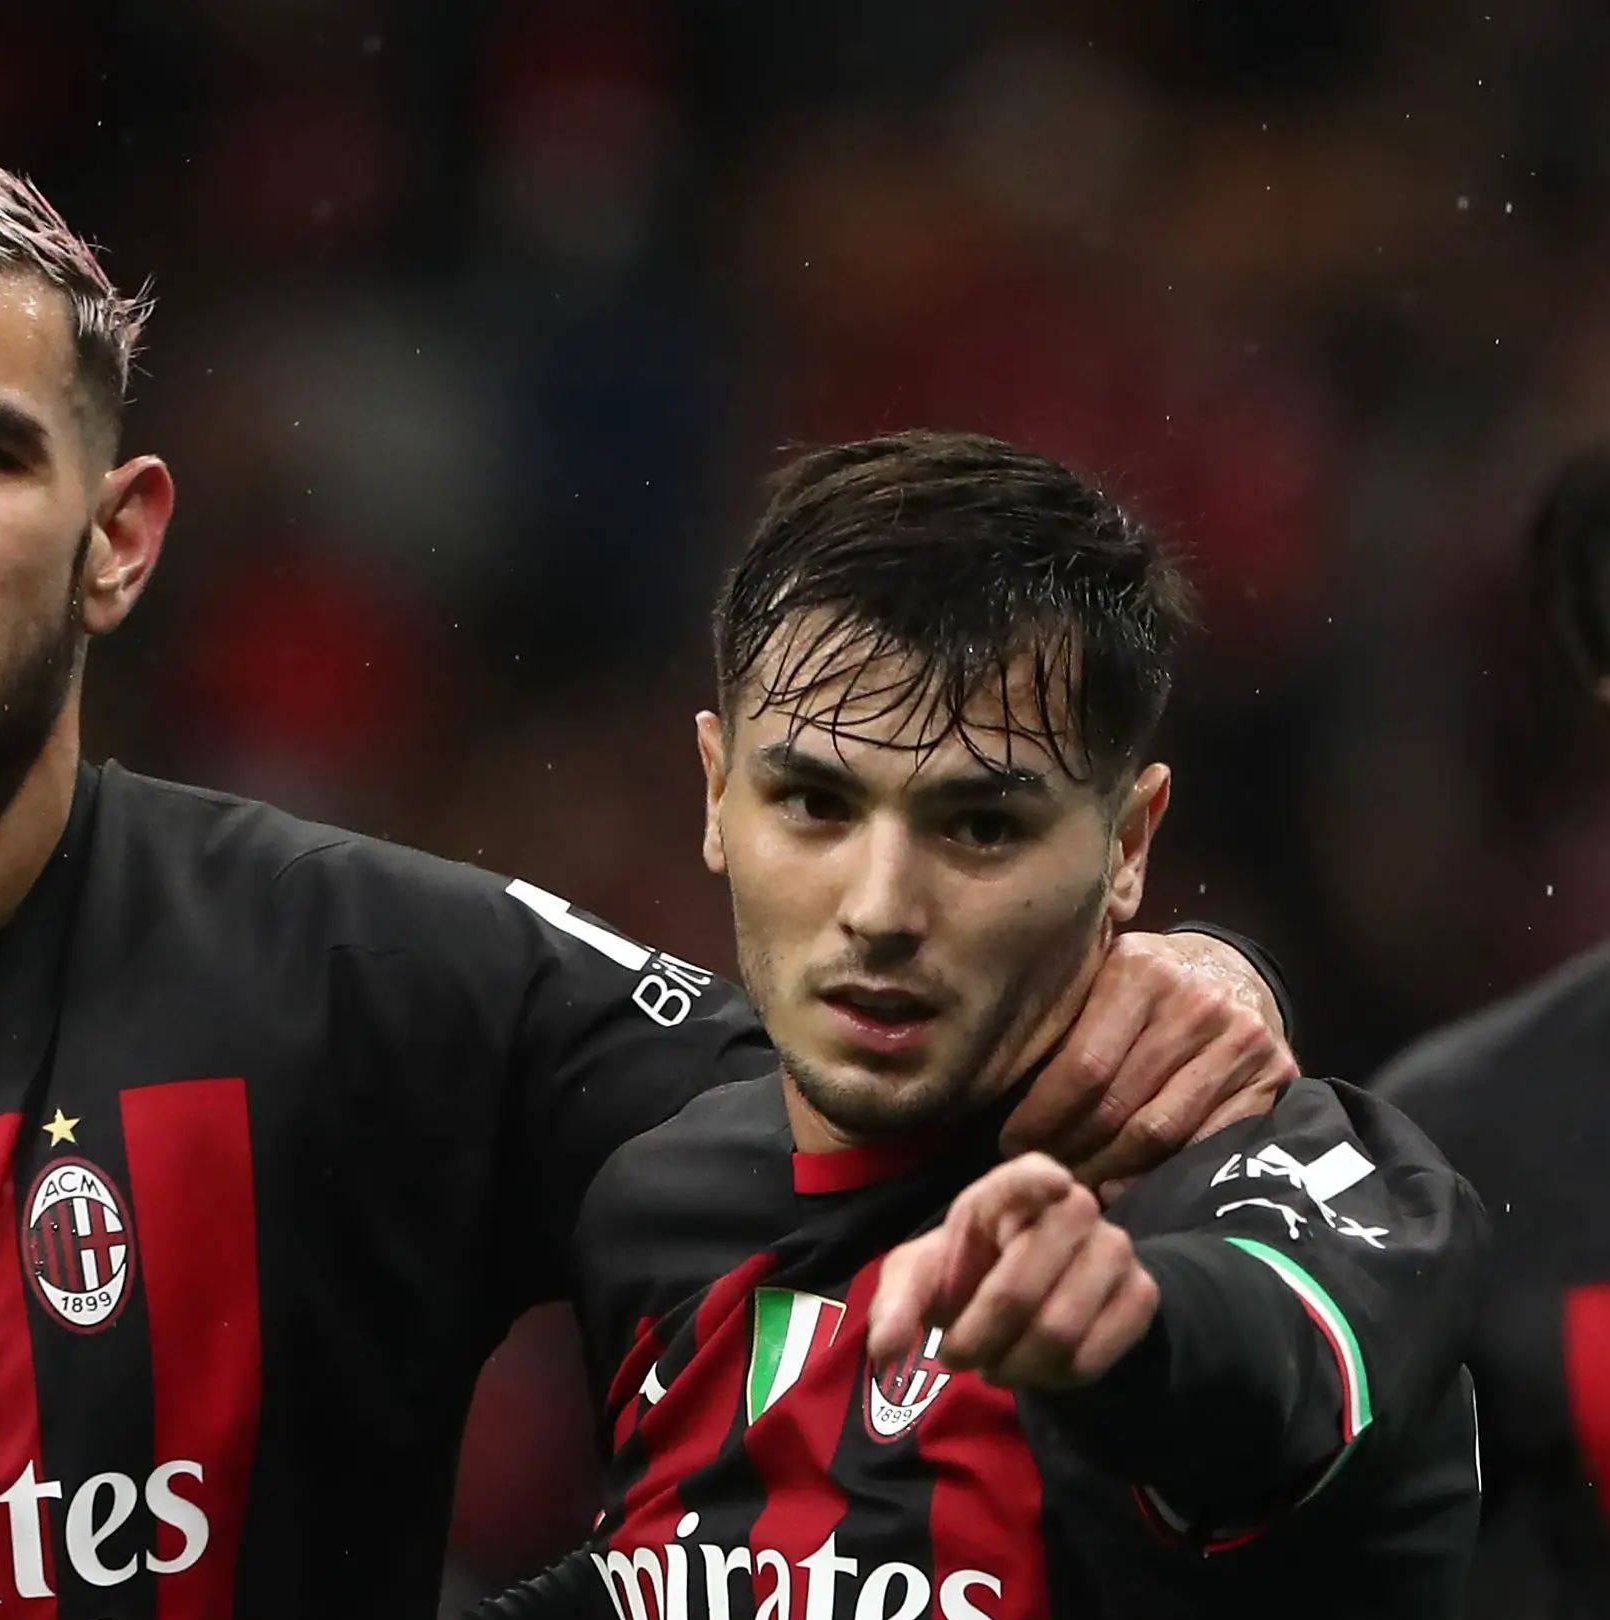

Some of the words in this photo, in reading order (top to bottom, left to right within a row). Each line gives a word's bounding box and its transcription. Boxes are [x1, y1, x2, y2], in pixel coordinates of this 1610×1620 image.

[42, 1171, 102, 1206] ACM
[61, 1291, 113, 1313] 1899
[875, 1405, 913, 1424] 1899
